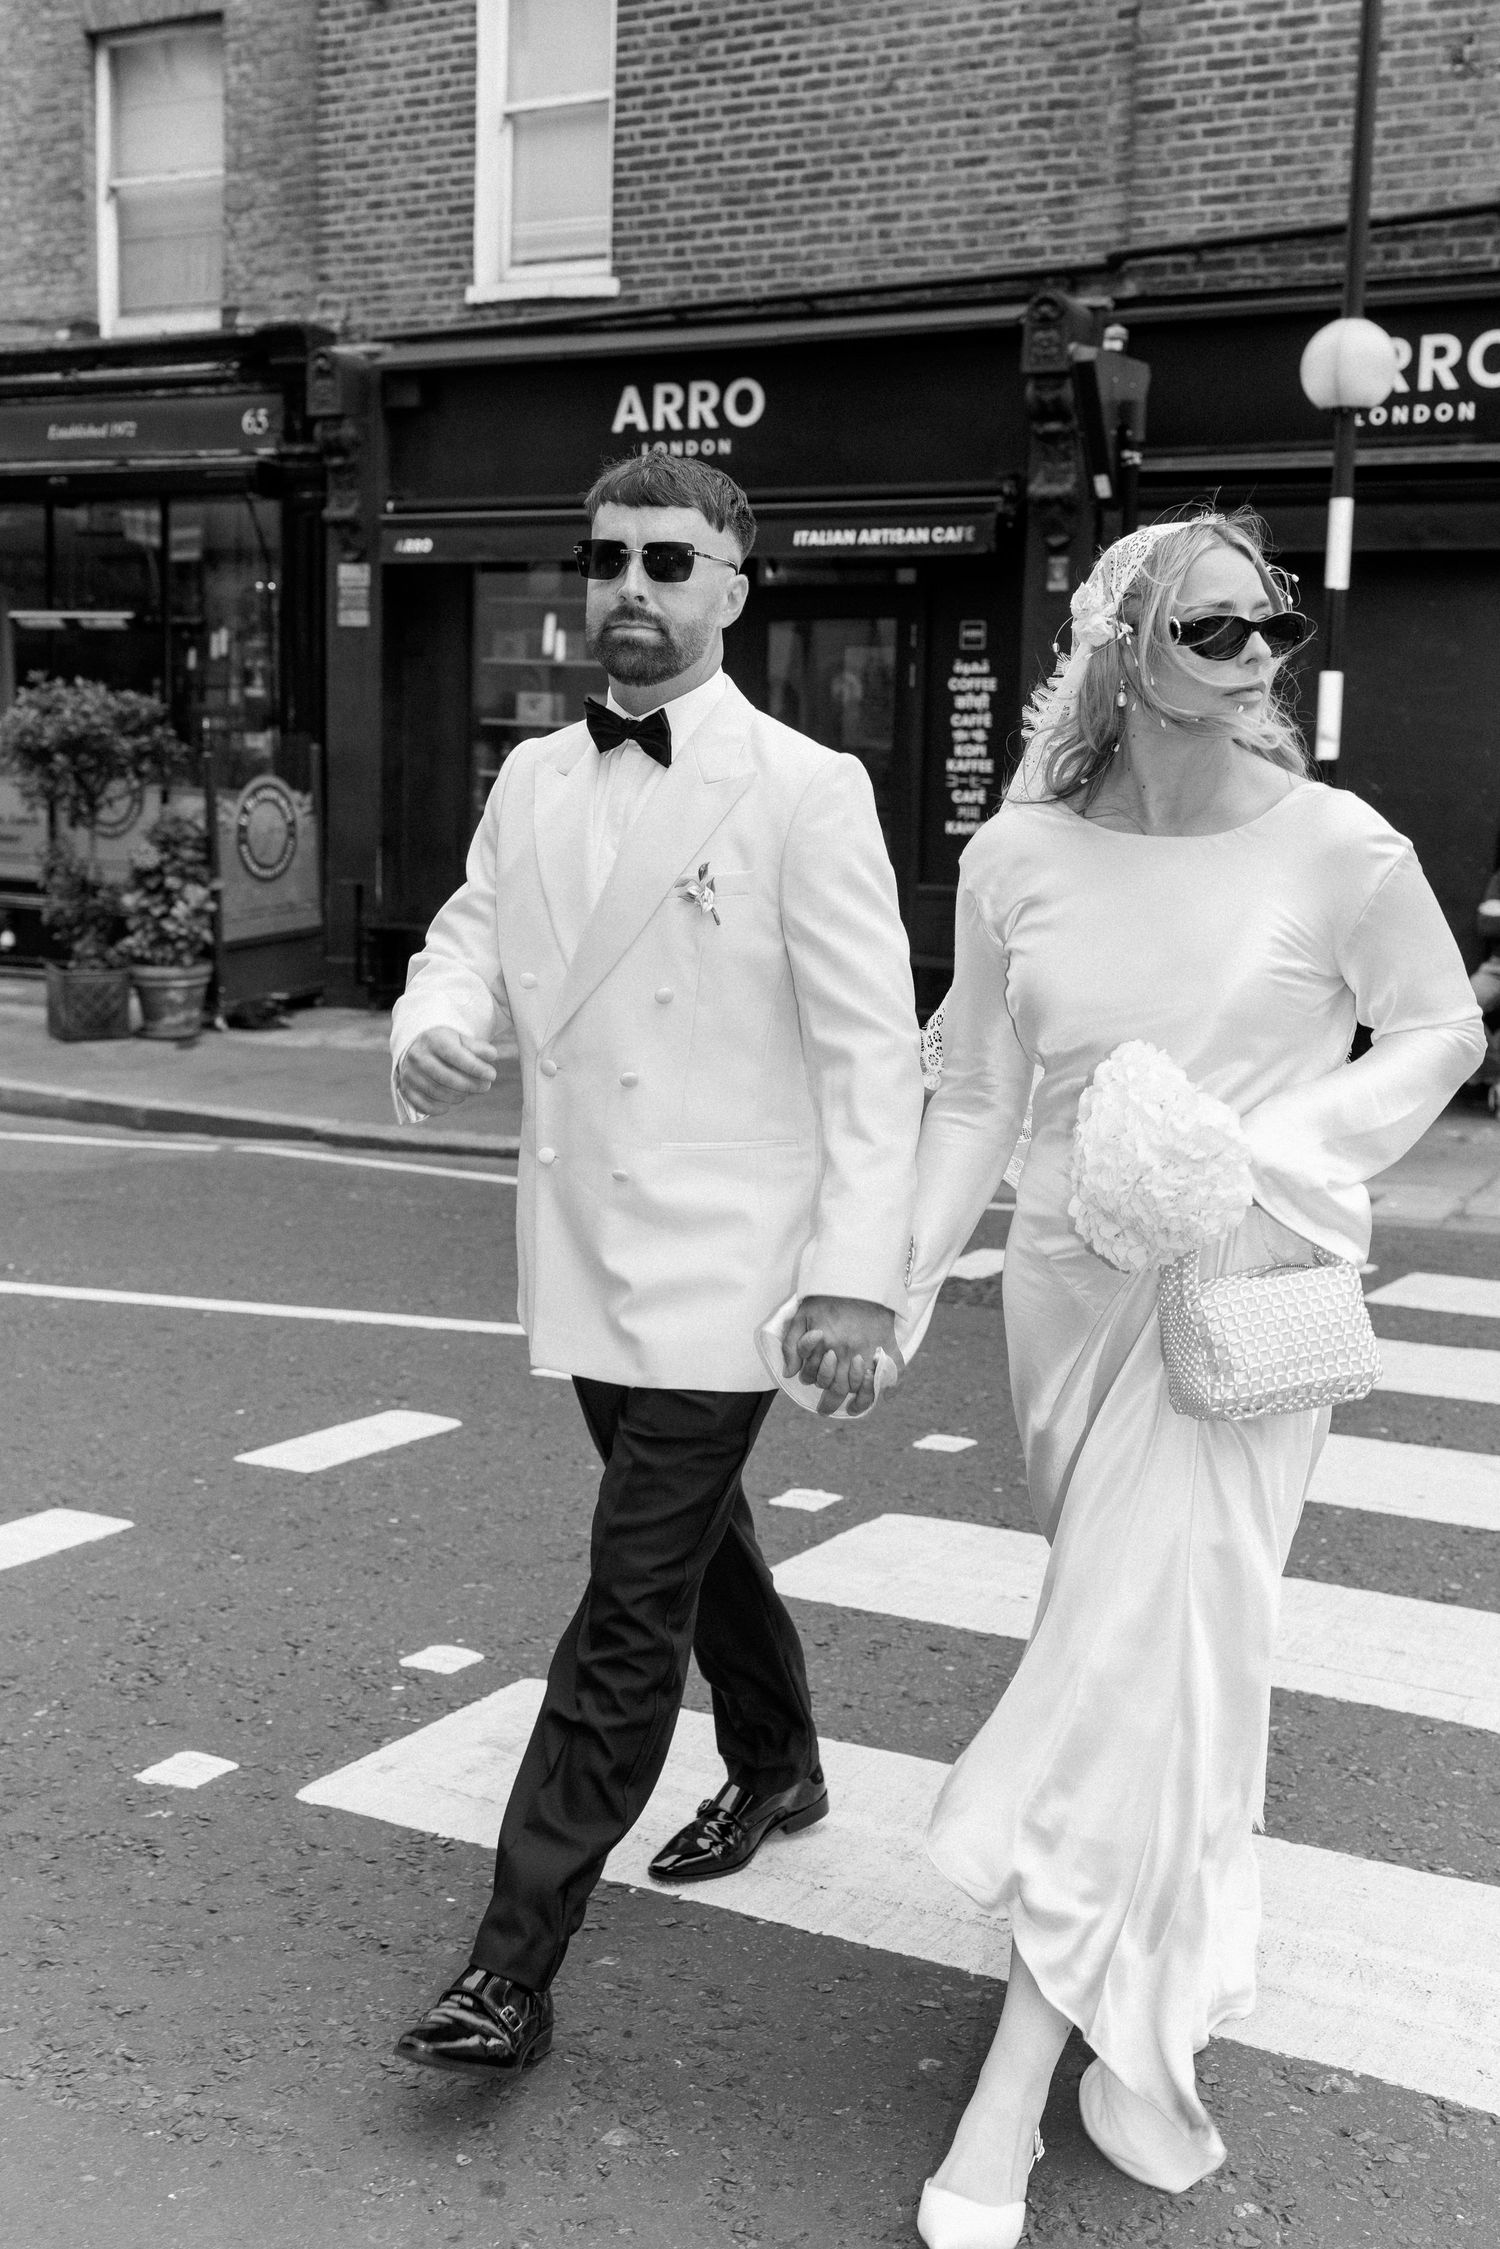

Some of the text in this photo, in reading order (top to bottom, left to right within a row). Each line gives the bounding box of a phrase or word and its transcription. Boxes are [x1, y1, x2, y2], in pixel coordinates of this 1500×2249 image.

[1389, 328, 1500, 394] RRO
[611, 377, 766, 433] ARRO
[1354, 400, 1476, 427] LONDON
[241, 407, 270, 435] 65
[641, 438, 732, 457] LONDON
[793, 529, 857, 547] ITALIAN
[857, 526, 930, 545] ARTISAN
[947, 676, 998, 692] COFFEE
[945, 758, 994, 773] KAFFEE
